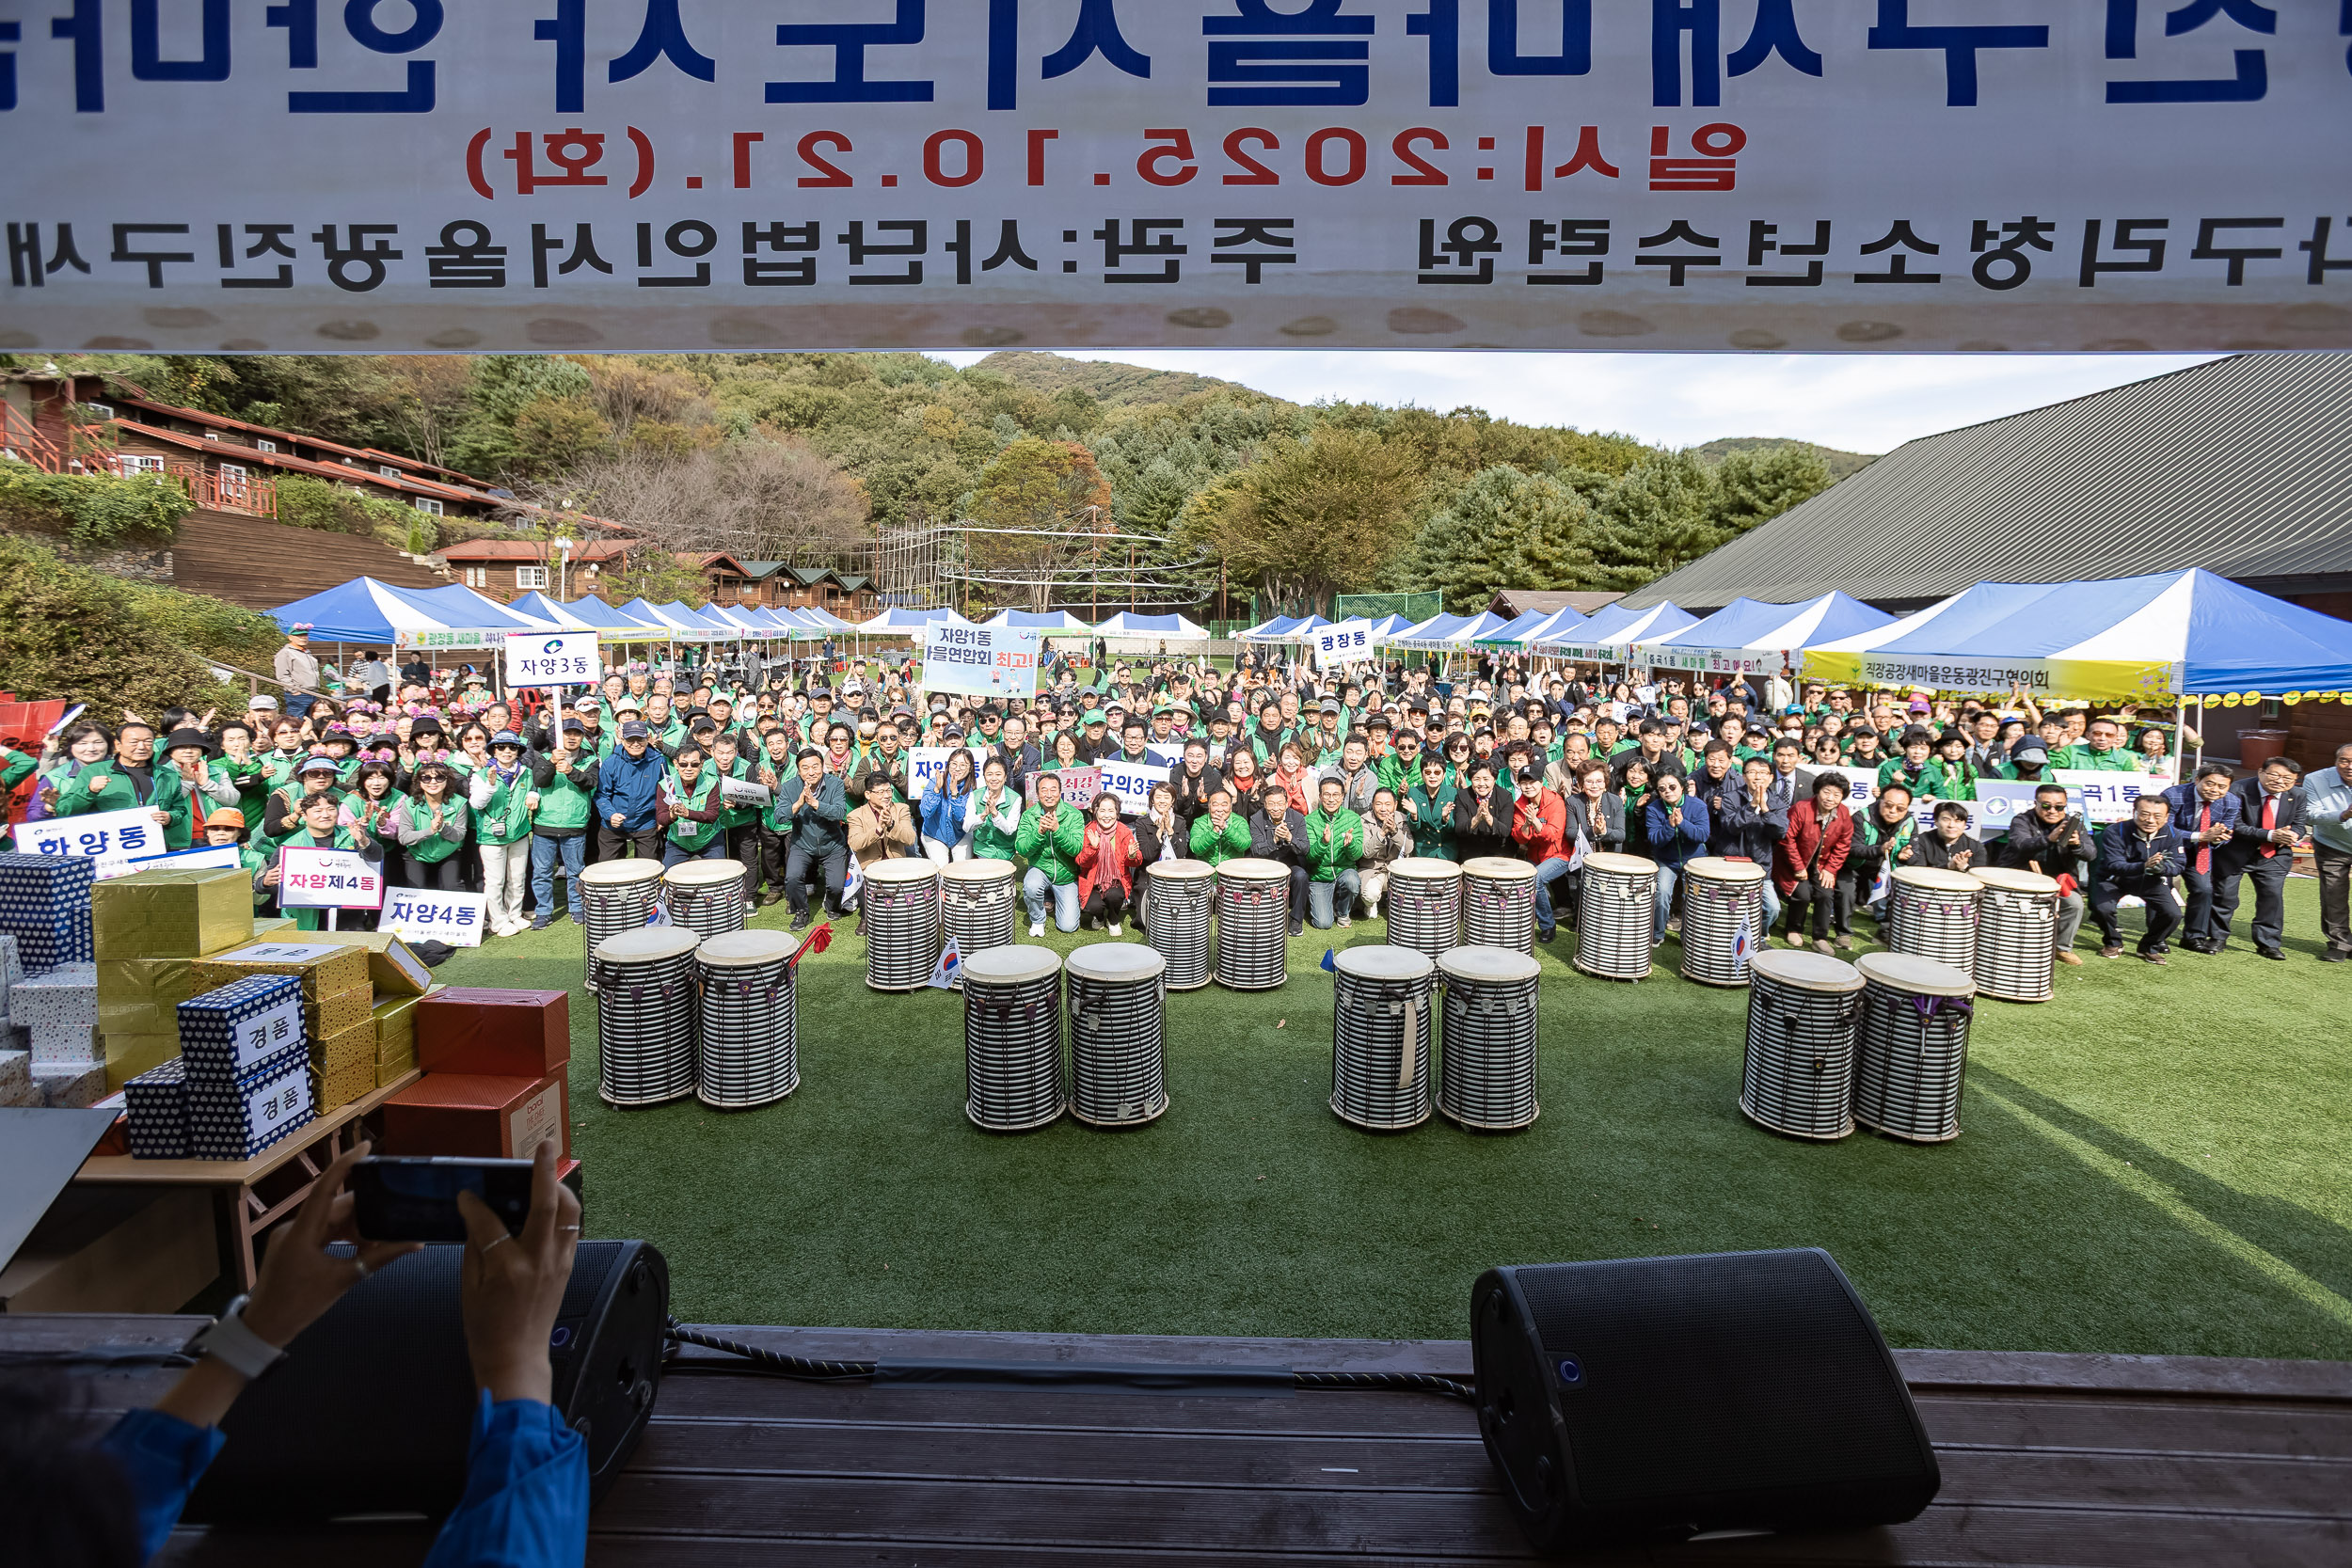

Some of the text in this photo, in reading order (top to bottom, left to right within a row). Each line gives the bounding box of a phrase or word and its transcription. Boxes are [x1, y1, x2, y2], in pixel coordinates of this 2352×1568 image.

[428, 632, 454, 646] 광장동
[939, 627, 992, 647] 자양1동
[1321, 630, 1366, 651] 광장동
[520, 657, 588, 675] 자양3동
[996, 651, 1033, 668] 최고!
[1649, 654, 1676, 667] 중곡1동
[1681, 657, 1707, 670] 새마을
[1866, 662, 2050, 689] 직장공장새마을운동광진구협의회
[1101, 773, 1160, 796] 구의3동
[2083, 784, 2141, 803] 곡1동
[289, 874, 374, 891] 자양제4동
[389, 902, 476, 926] 자양4동
[248, 1016, 290, 1050] 경품
[262, 1085, 299, 1120] 경품
